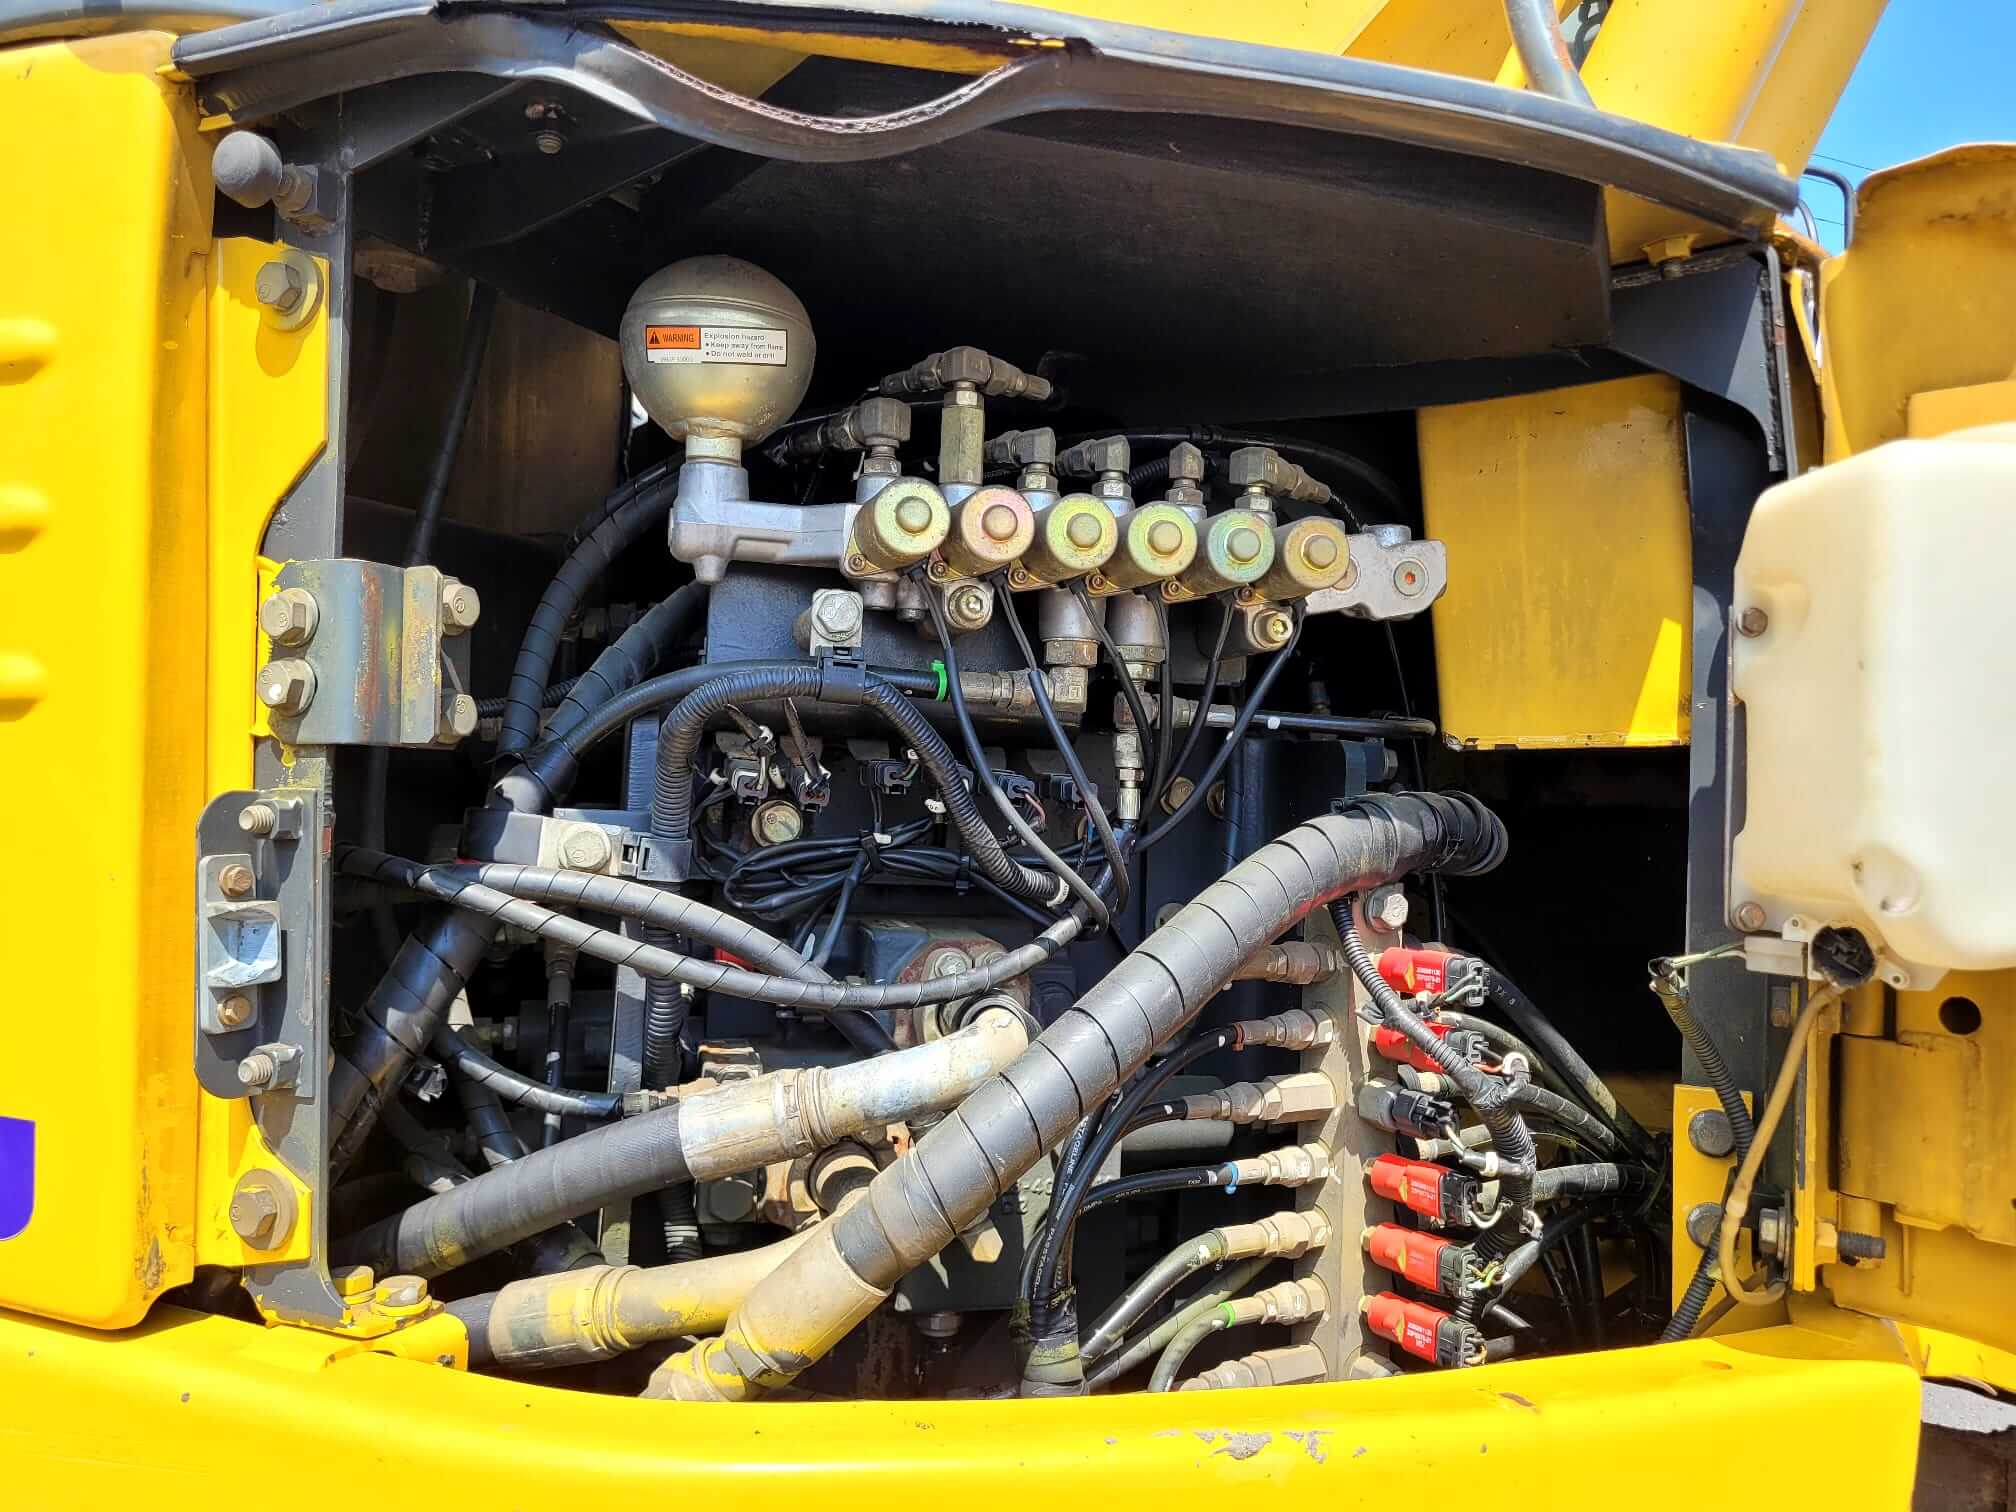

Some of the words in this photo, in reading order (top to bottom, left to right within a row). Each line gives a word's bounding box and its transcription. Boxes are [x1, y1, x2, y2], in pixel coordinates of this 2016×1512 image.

[662, 333, 694, 343] WARNING
[704, 332, 740, 341] Explosion
[710, 342, 730, 350] Keep
[732, 343, 750, 351] away
[736, 351, 753, 359] weld
